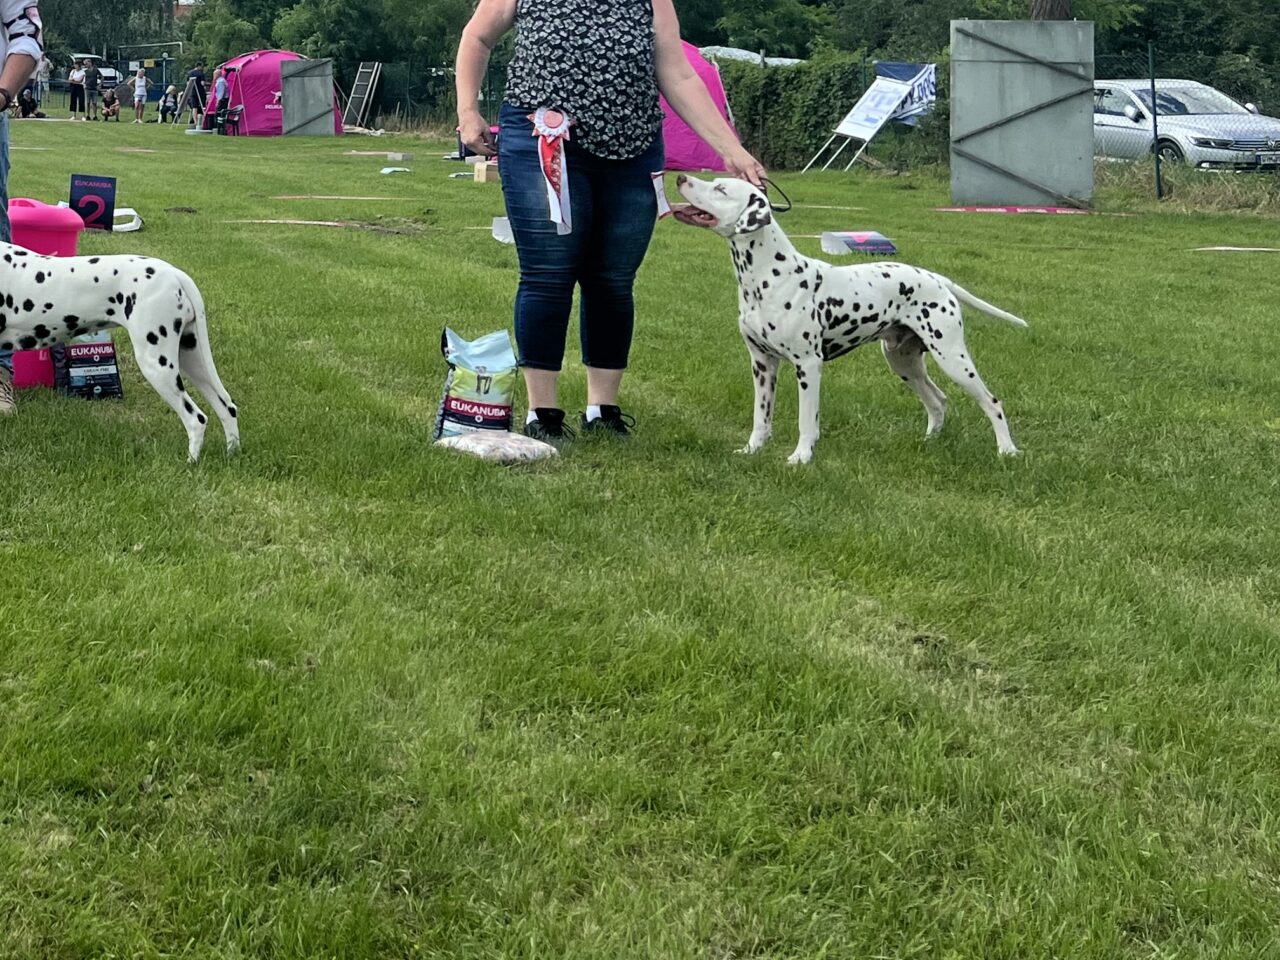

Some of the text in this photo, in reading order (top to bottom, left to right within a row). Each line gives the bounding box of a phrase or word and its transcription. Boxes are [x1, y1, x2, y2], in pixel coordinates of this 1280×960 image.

[74, 180, 113, 189] EUKANUBA
[78, 194, 105, 229] 2
[70, 345, 114, 356] EUKANUBA
[450, 400, 506, 417] EUKANUBA
